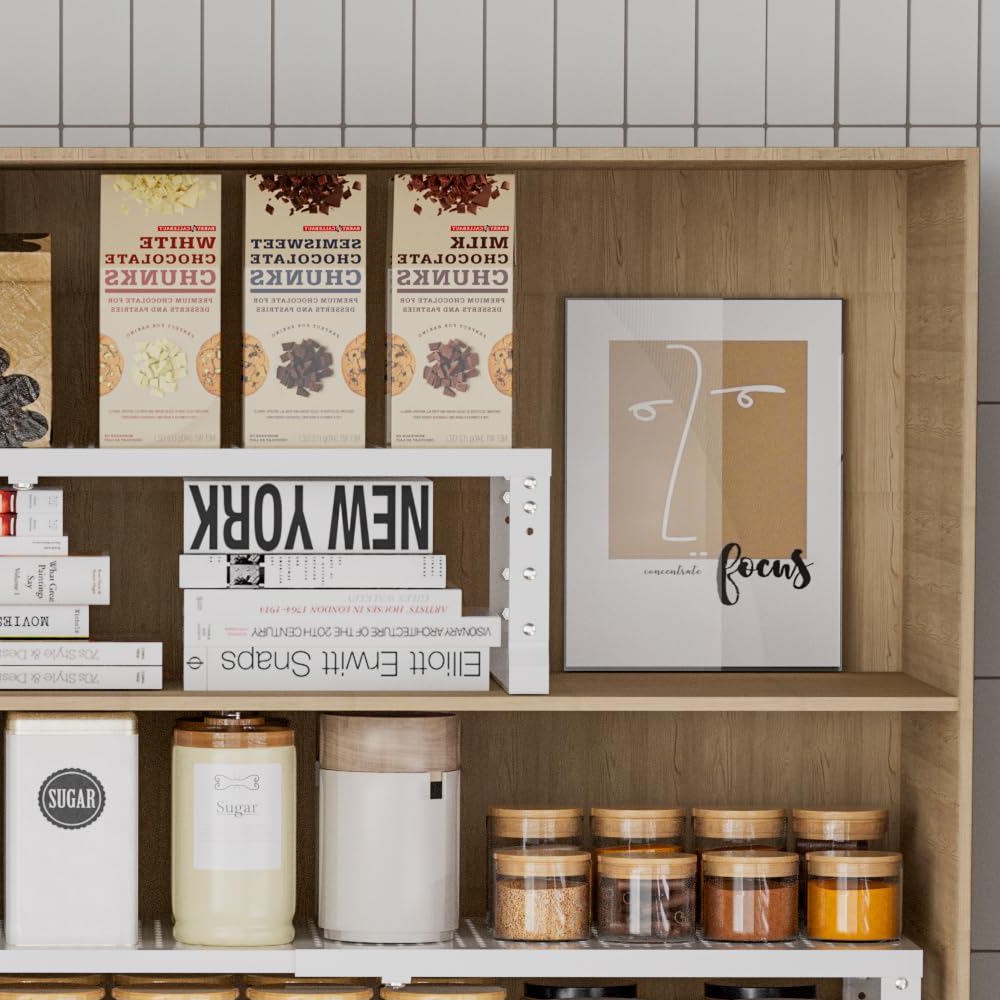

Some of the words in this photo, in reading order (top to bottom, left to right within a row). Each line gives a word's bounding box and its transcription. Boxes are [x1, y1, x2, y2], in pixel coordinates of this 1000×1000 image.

[189, 483, 314, 551] YORK
[328, 485, 429, 550] NEW
[49, 561, 57, 581] What
[643, 564, 702, 576] concentrate
[716, 542, 815, 606] focus
[25, 576, 34, 589] Say
[311, 606, 350, 614] LONDON
[354, 606, 364, 614] IN
[252, 627, 302, 637] CENTURY
[303, 627, 332, 637] 20TH
[334, 627, 353, 637] THE
[356, 627, 369, 637] OF
[370, 627, 442, 637] ARCHITECTURE
[445, 627, 492, 637] VISIONARY
[31, 648, 41, 659] &
[43, 647, 77, 660] Style
[221, 646, 311, 677] Snaps
[322, 650, 398, 677] Erwitt
[409, 650, 481, 677] Elliott
[31, 672, 41, 683] &
[43, 671, 77, 684] Style
[49, 788, 96, 809] SUGAR
[216, 800, 258, 817] Sugar
